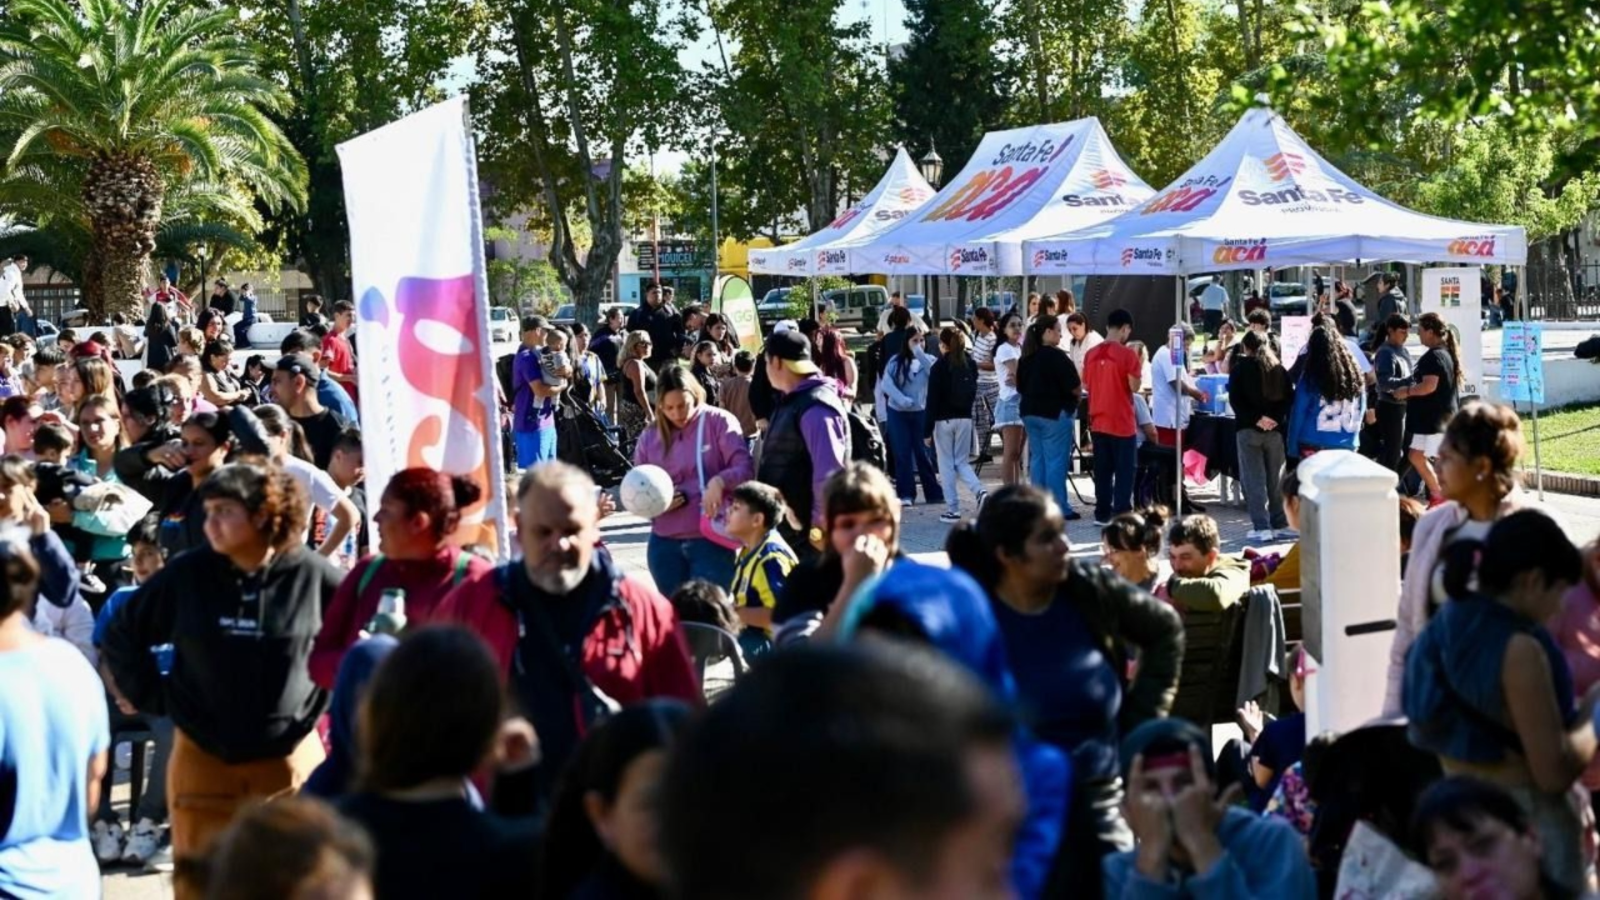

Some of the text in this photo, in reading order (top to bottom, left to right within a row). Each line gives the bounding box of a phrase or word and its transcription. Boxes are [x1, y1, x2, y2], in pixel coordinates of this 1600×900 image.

[992, 139, 1054, 165] Santa Fe
[1238, 185, 1364, 205] Santa Fe
[1134, 248, 1153, 260] Santa
[1152, 248, 1162, 260] Fe
